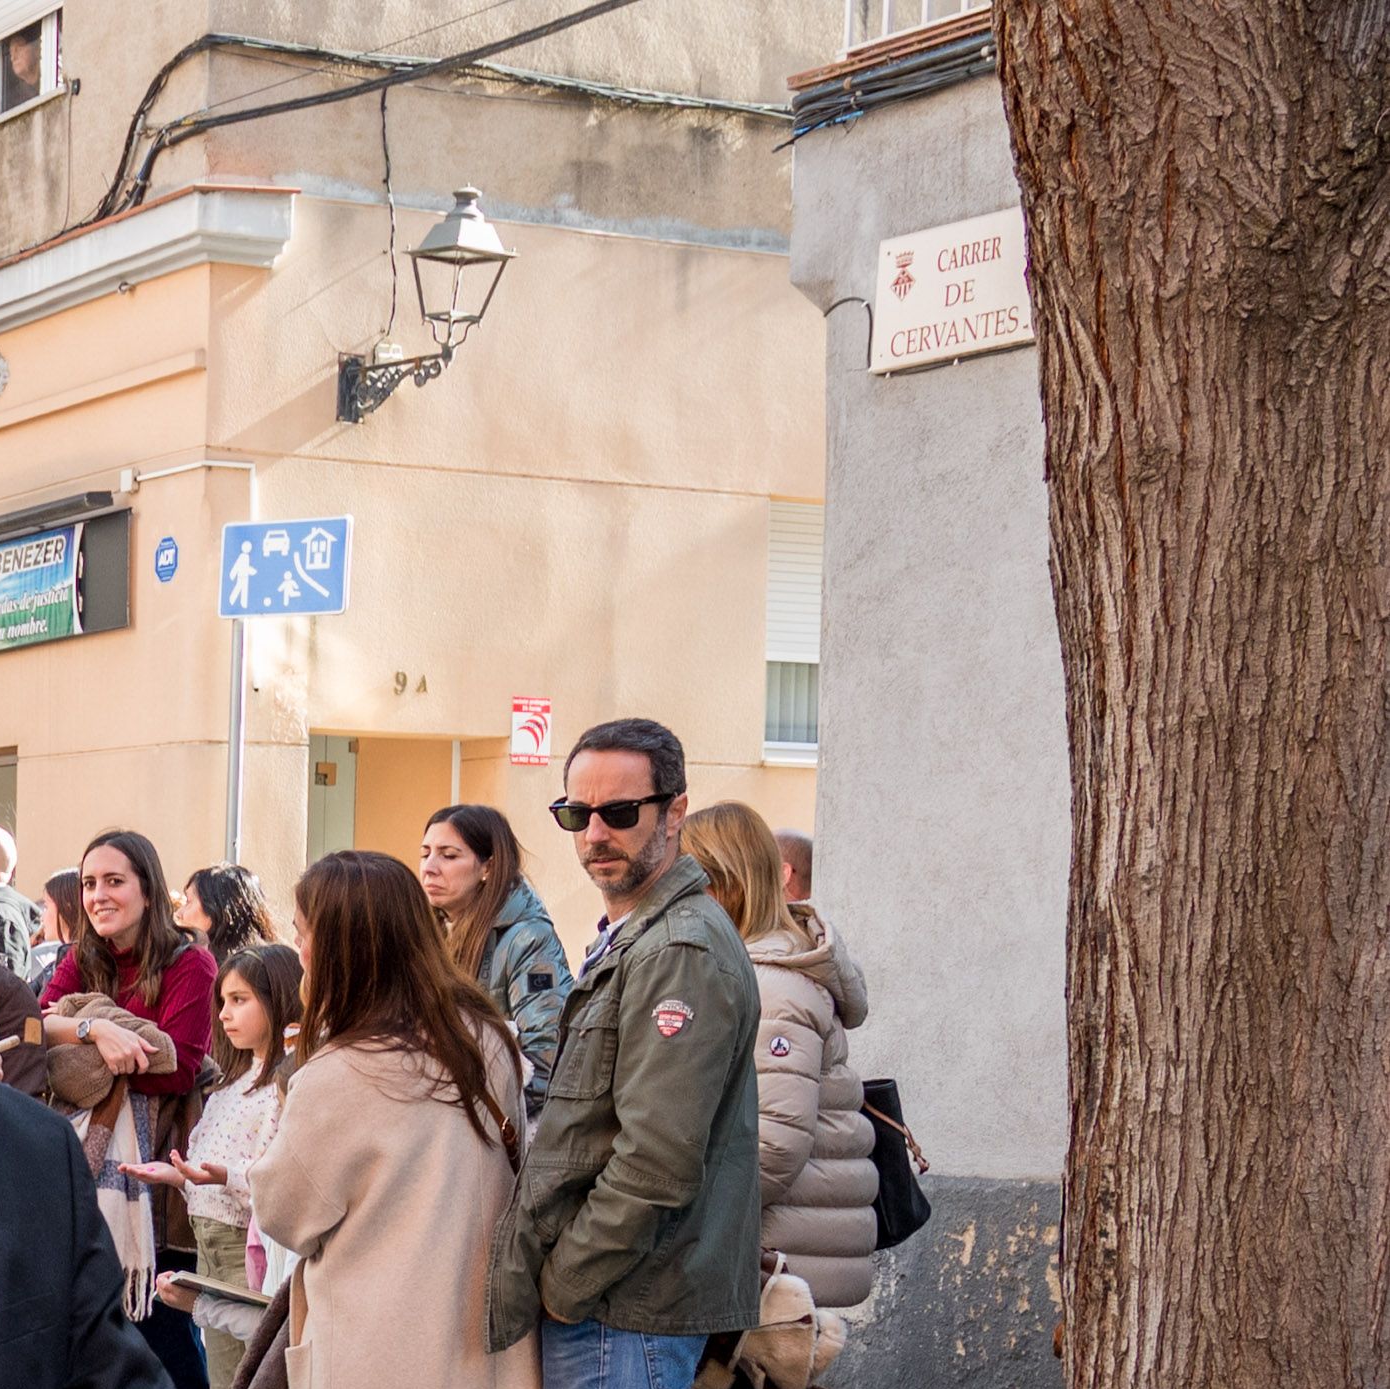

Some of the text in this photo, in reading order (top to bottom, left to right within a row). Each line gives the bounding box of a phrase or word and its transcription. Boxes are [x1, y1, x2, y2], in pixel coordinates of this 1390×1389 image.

[936, 235, 1002, 273] CARRER
[944, 279, 975, 307] DE
[889, 306, 1020, 358] CERVANTES
[158, 548, 176, 568] ADT
[19, 590, 33, 611] de
[31, 584, 69, 614] justicia
[7, 617, 48, 638] nombre.
[393, 671, 428, 695] 9 A
